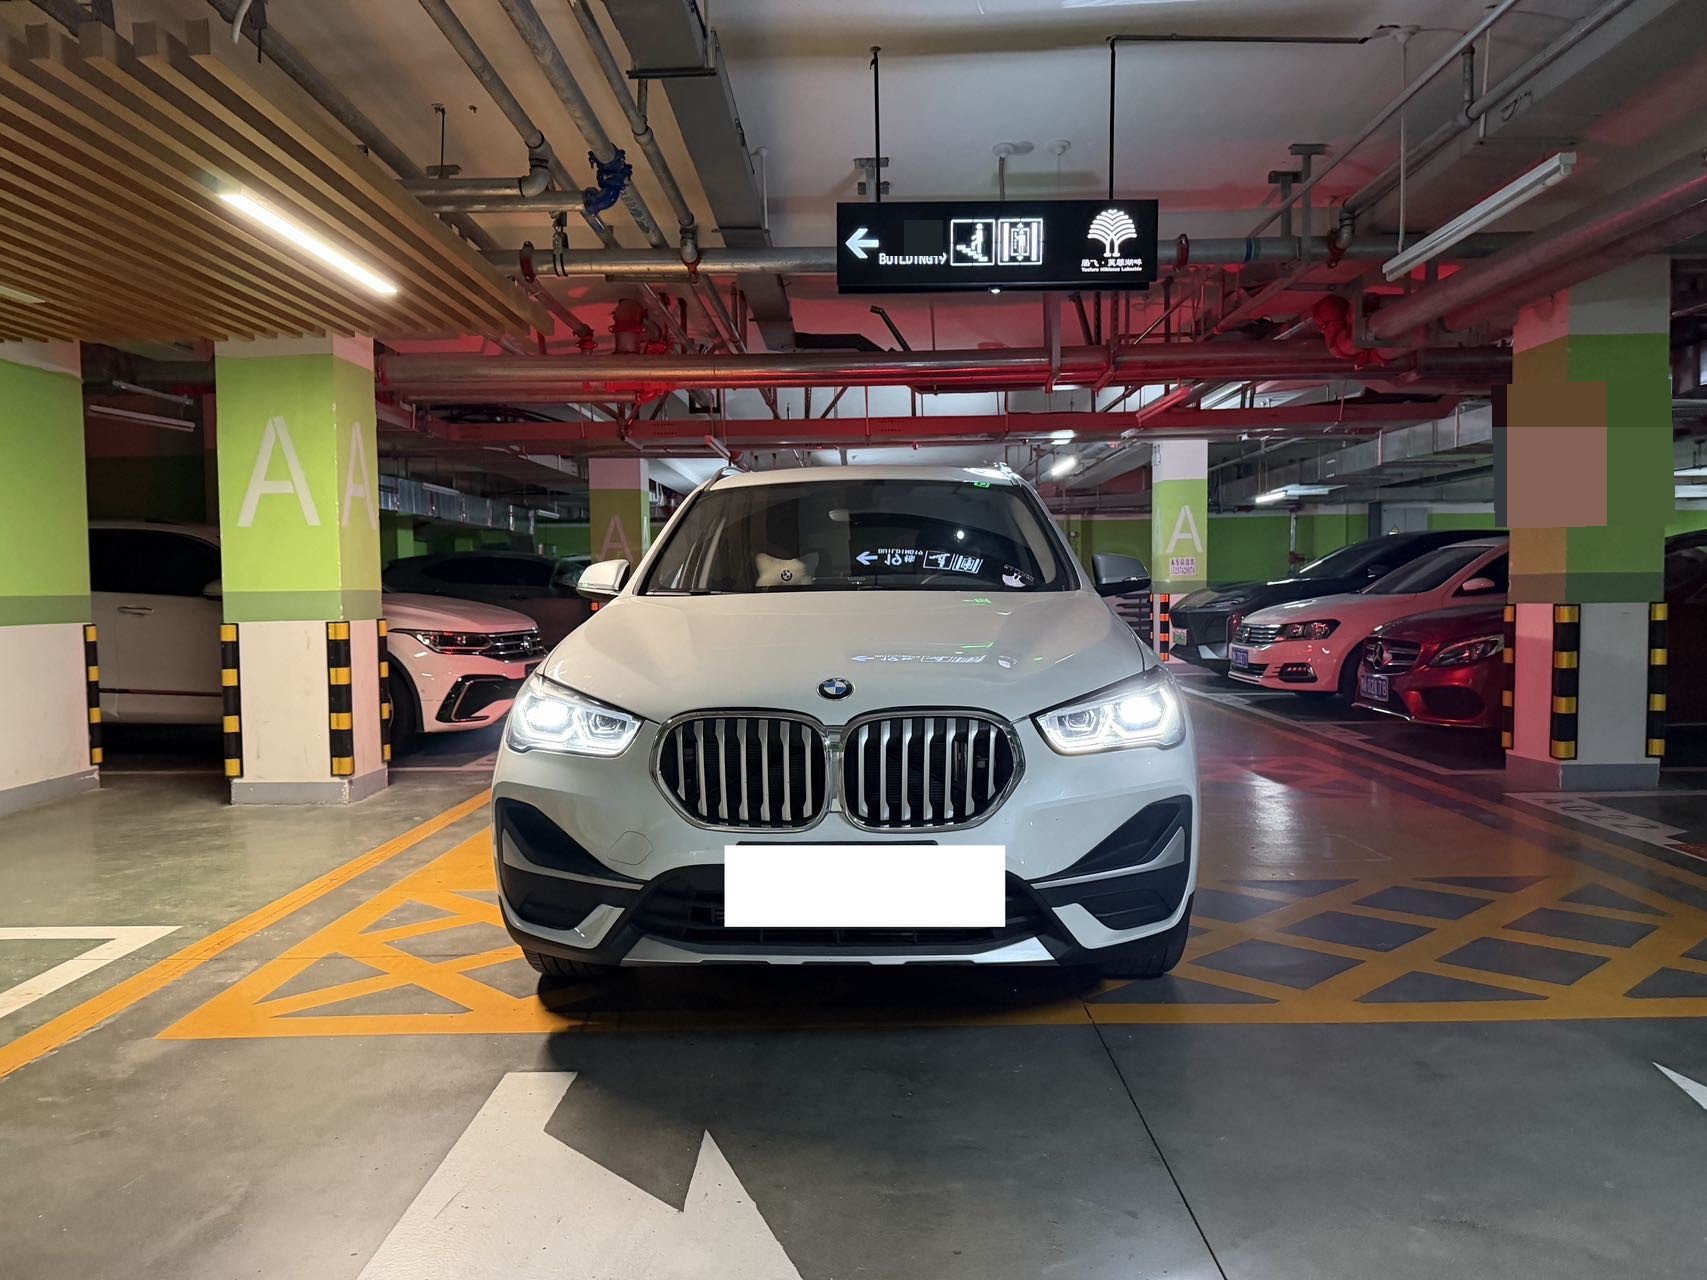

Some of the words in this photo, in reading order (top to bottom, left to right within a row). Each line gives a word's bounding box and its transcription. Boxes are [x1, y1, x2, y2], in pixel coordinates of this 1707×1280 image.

[237, 416, 321, 527] A
[341, 421, 377, 529] A
[597, 513, 634, 562] A
[1167, 505, 1203, 552] A
